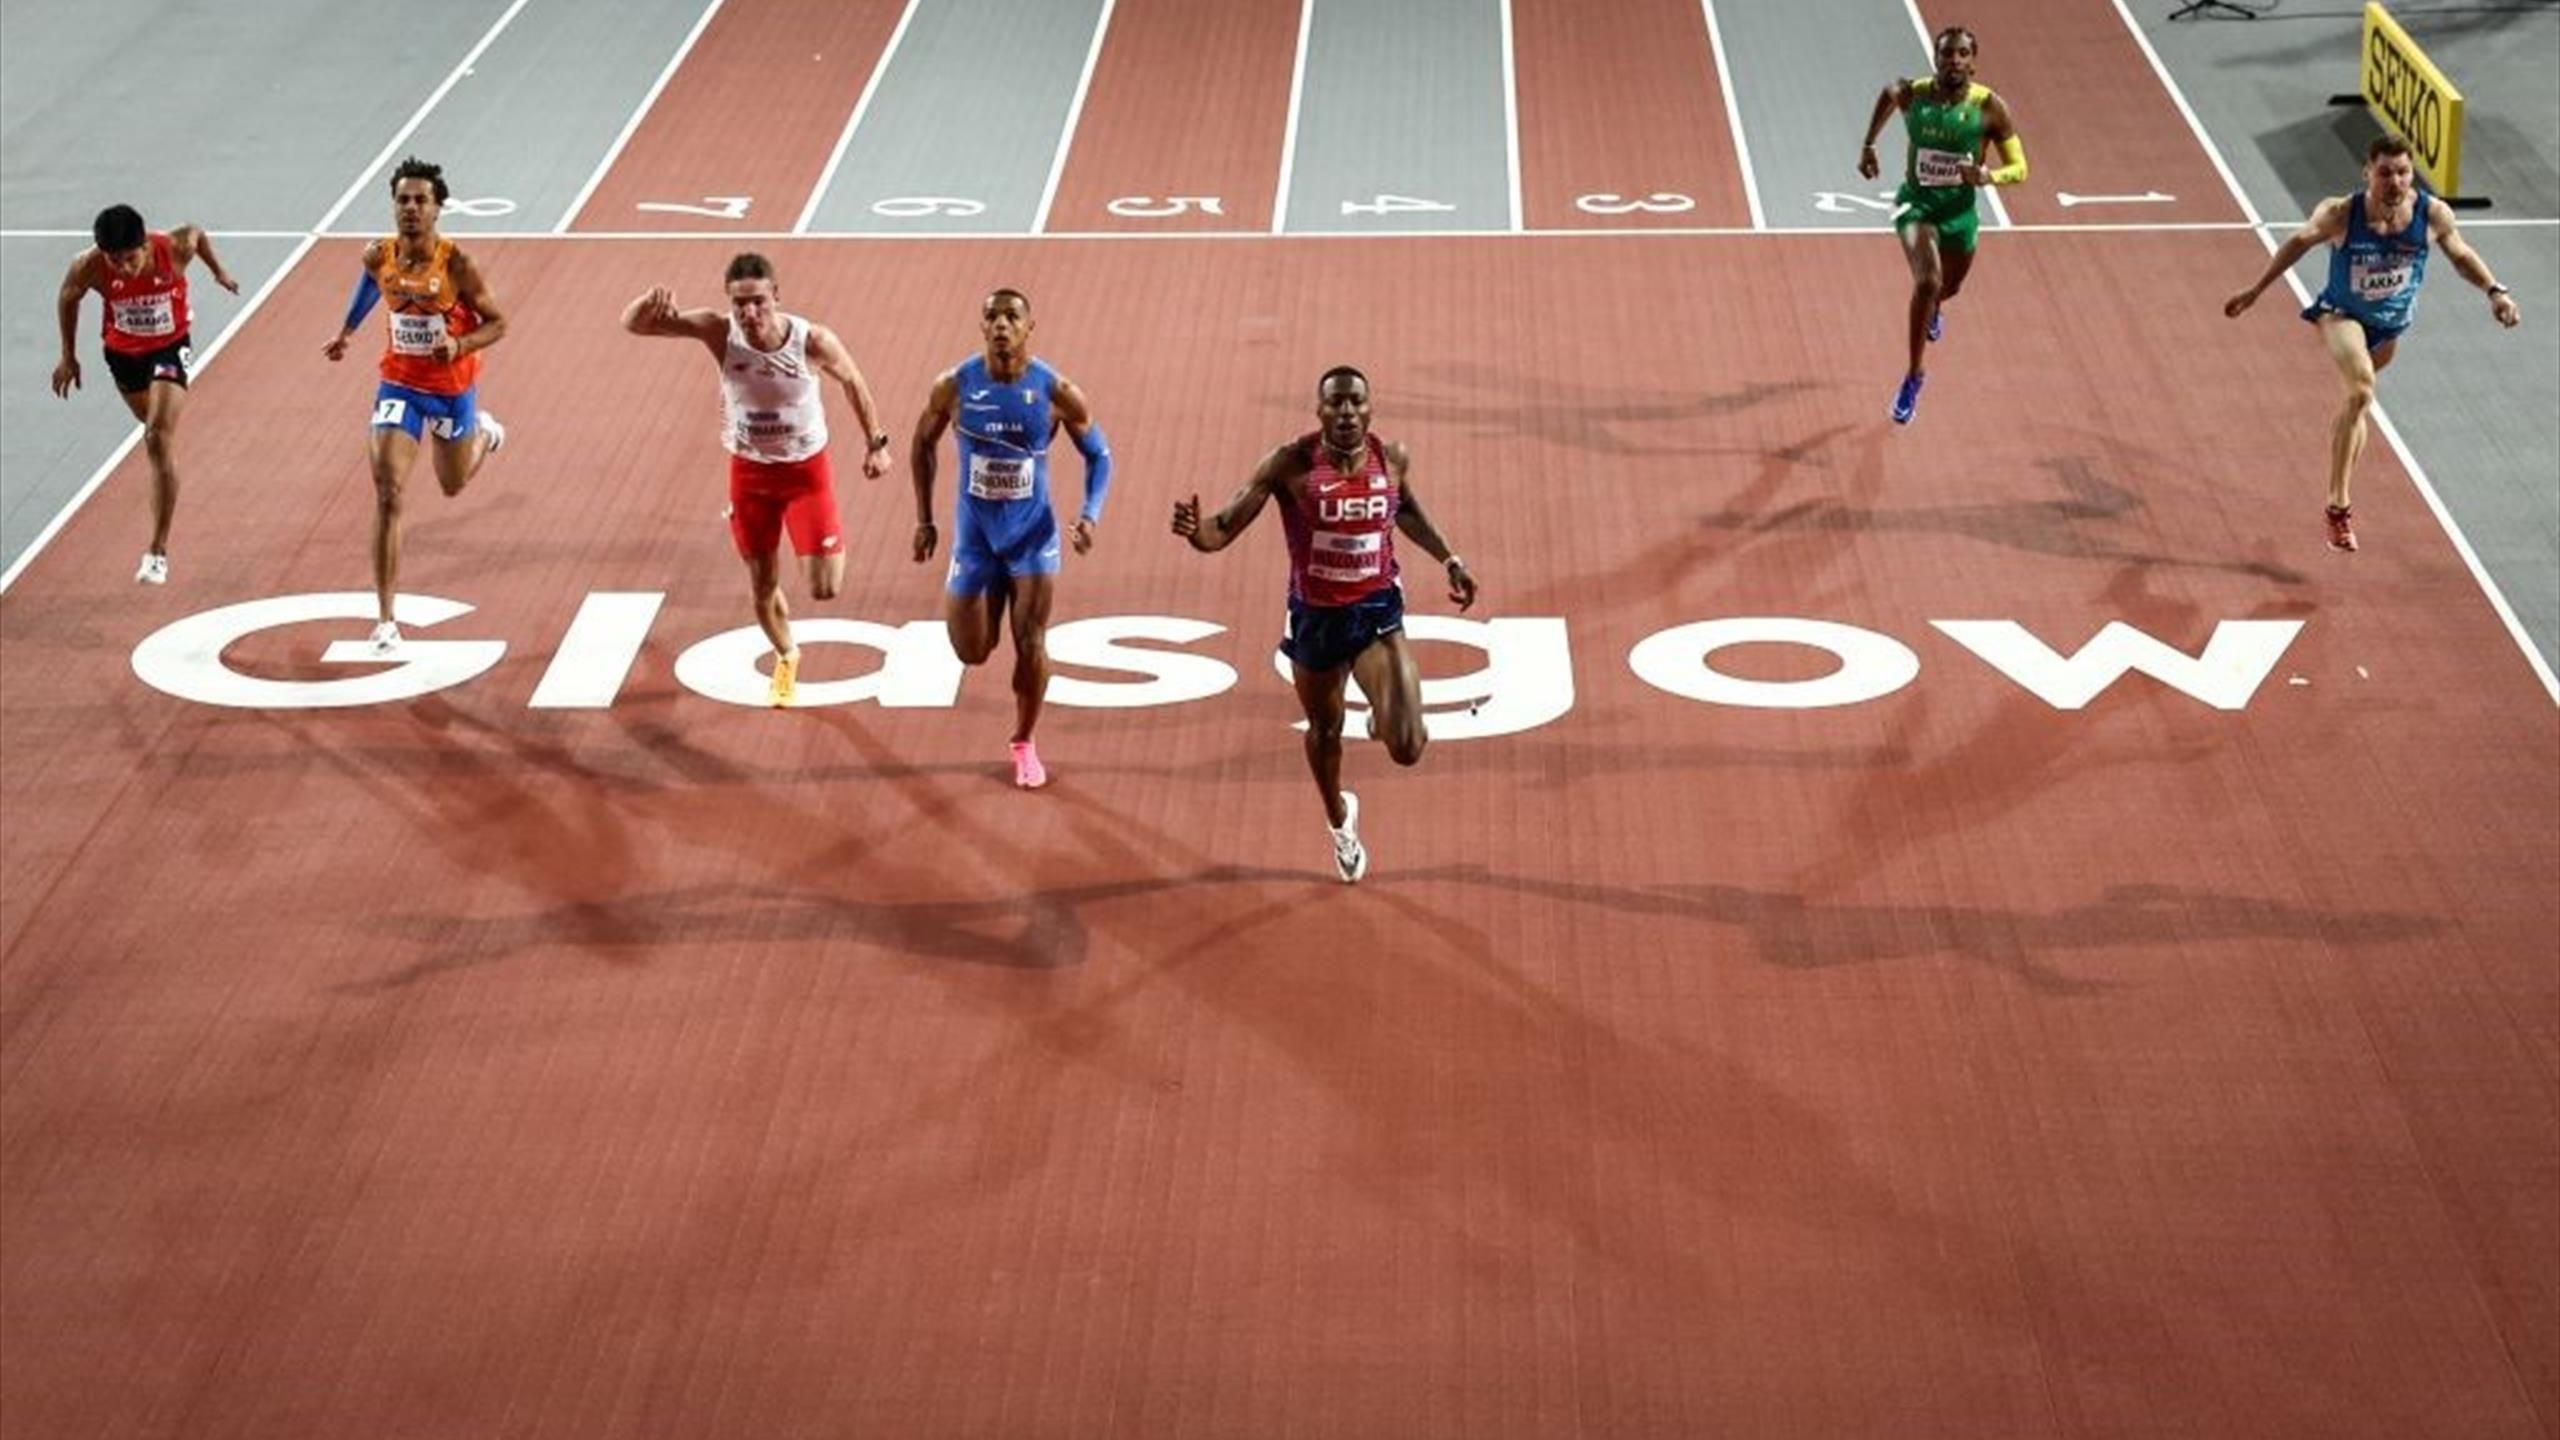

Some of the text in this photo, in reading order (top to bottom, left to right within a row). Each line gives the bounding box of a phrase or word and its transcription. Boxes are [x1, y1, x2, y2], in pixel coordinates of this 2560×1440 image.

[2369, 26, 2441, 170] SEIKO
[440, 197, 519, 217] 8
[637, 197, 753, 219] 7
[870, 196, 988, 218] 6
[1107, 197, 1223, 217] 5
[1341, 195, 1457, 216] 4
[1576, 194, 1696, 213] 3
[1812, 191, 1911, 221] 2
[2056, 192, 2176, 207] 1
[2360, 274, 2404, 291] LAKKA
[383, 402, 397, 420] 7
[1320, 495, 1388, 521] USA
[131, 592, 2306, 740] Glasgow
